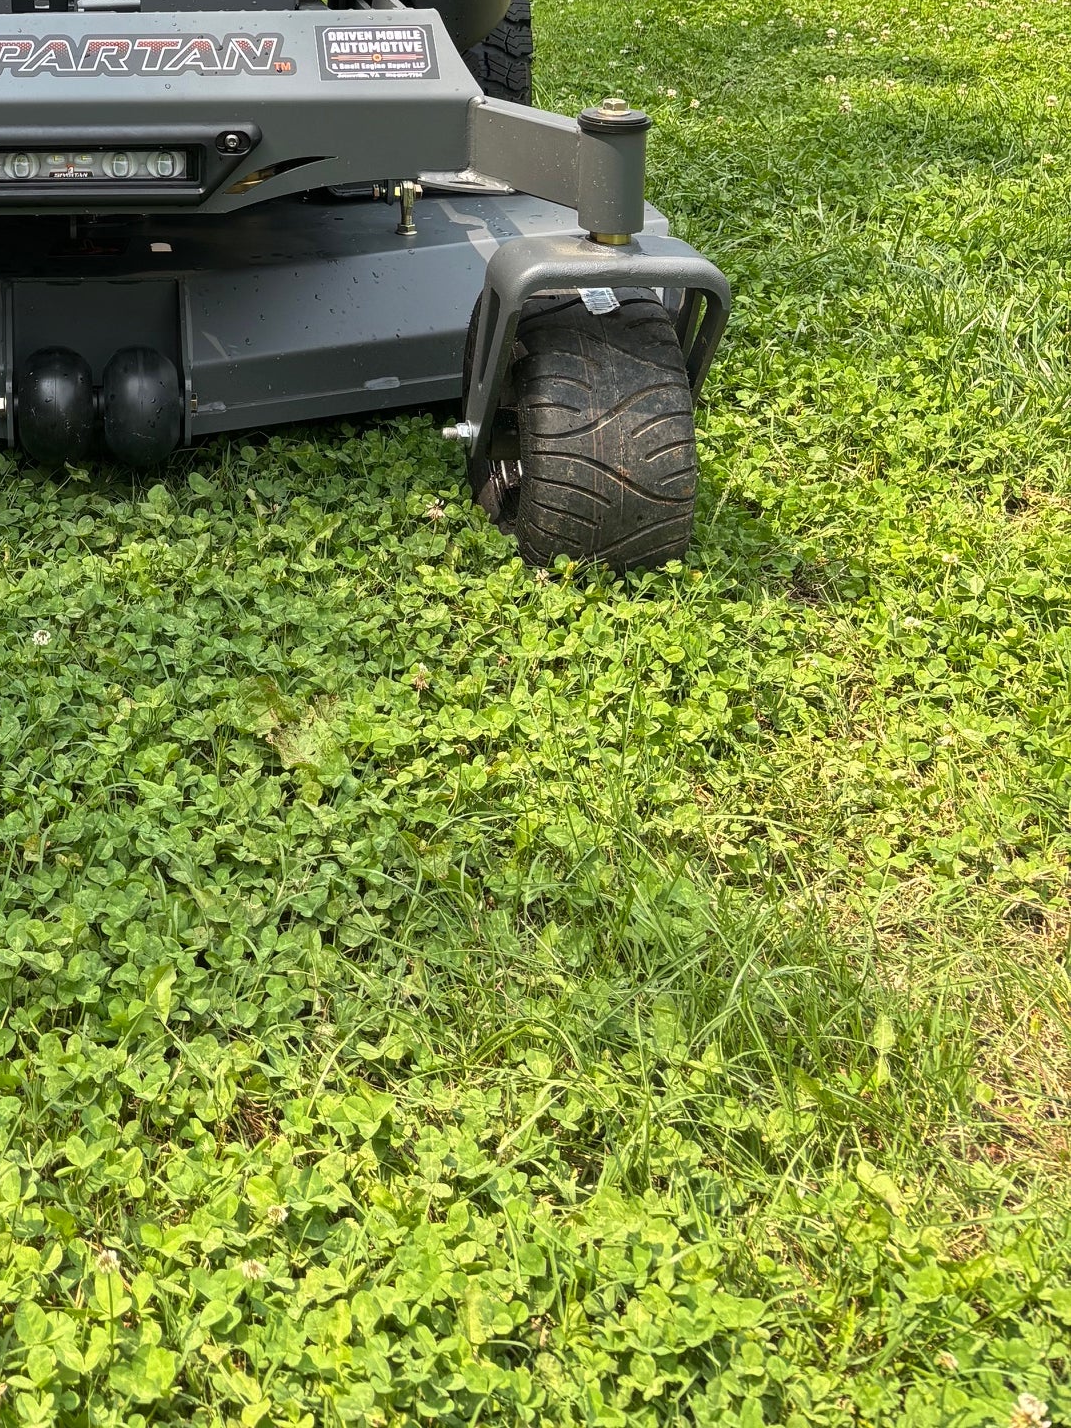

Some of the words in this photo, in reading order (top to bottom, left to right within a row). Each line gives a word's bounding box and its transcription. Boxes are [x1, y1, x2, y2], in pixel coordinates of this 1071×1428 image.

[328, 31, 373, 41] DRIVEN
[376, 30, 421, 40] MOBILE
[330, 41, 424, 53] AUTOMOTIVE
[339, 62, 360, 70] Small
[361, 61, 385, 71] Engine
[387, 61, 411, 70] Repair
[412, 61, 425, 69] LLC
